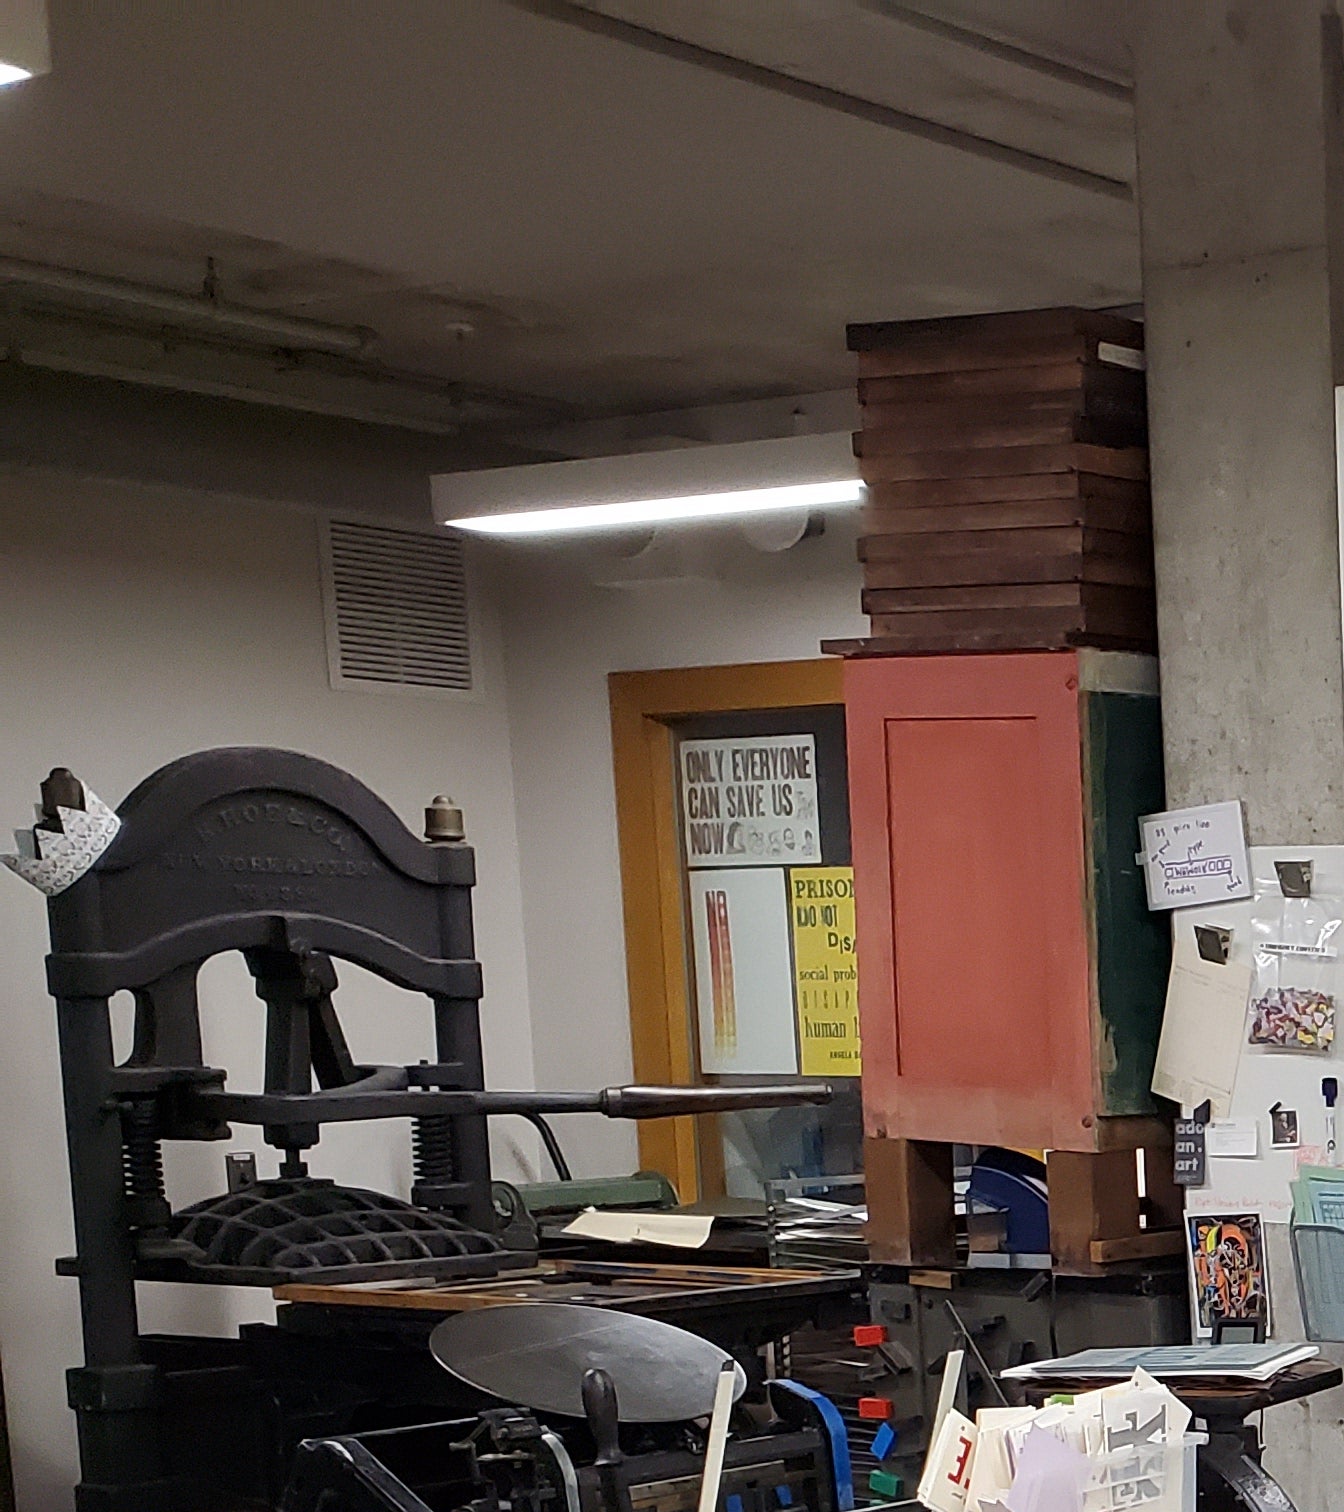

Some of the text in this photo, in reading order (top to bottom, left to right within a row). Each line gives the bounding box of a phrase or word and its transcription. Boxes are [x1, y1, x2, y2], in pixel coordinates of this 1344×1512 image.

[685, 746, 811, 783] ONLY EVERYONE
[688, 783, 793, 819] CAN SAVE US
[690, 822, 724, 855] NOW
[795, 879, 855, 898] PRISO
[828, 932, 856, 955] DIS
[799, 965, 828, 981] social
[805, 1015, 847, 1039] human
